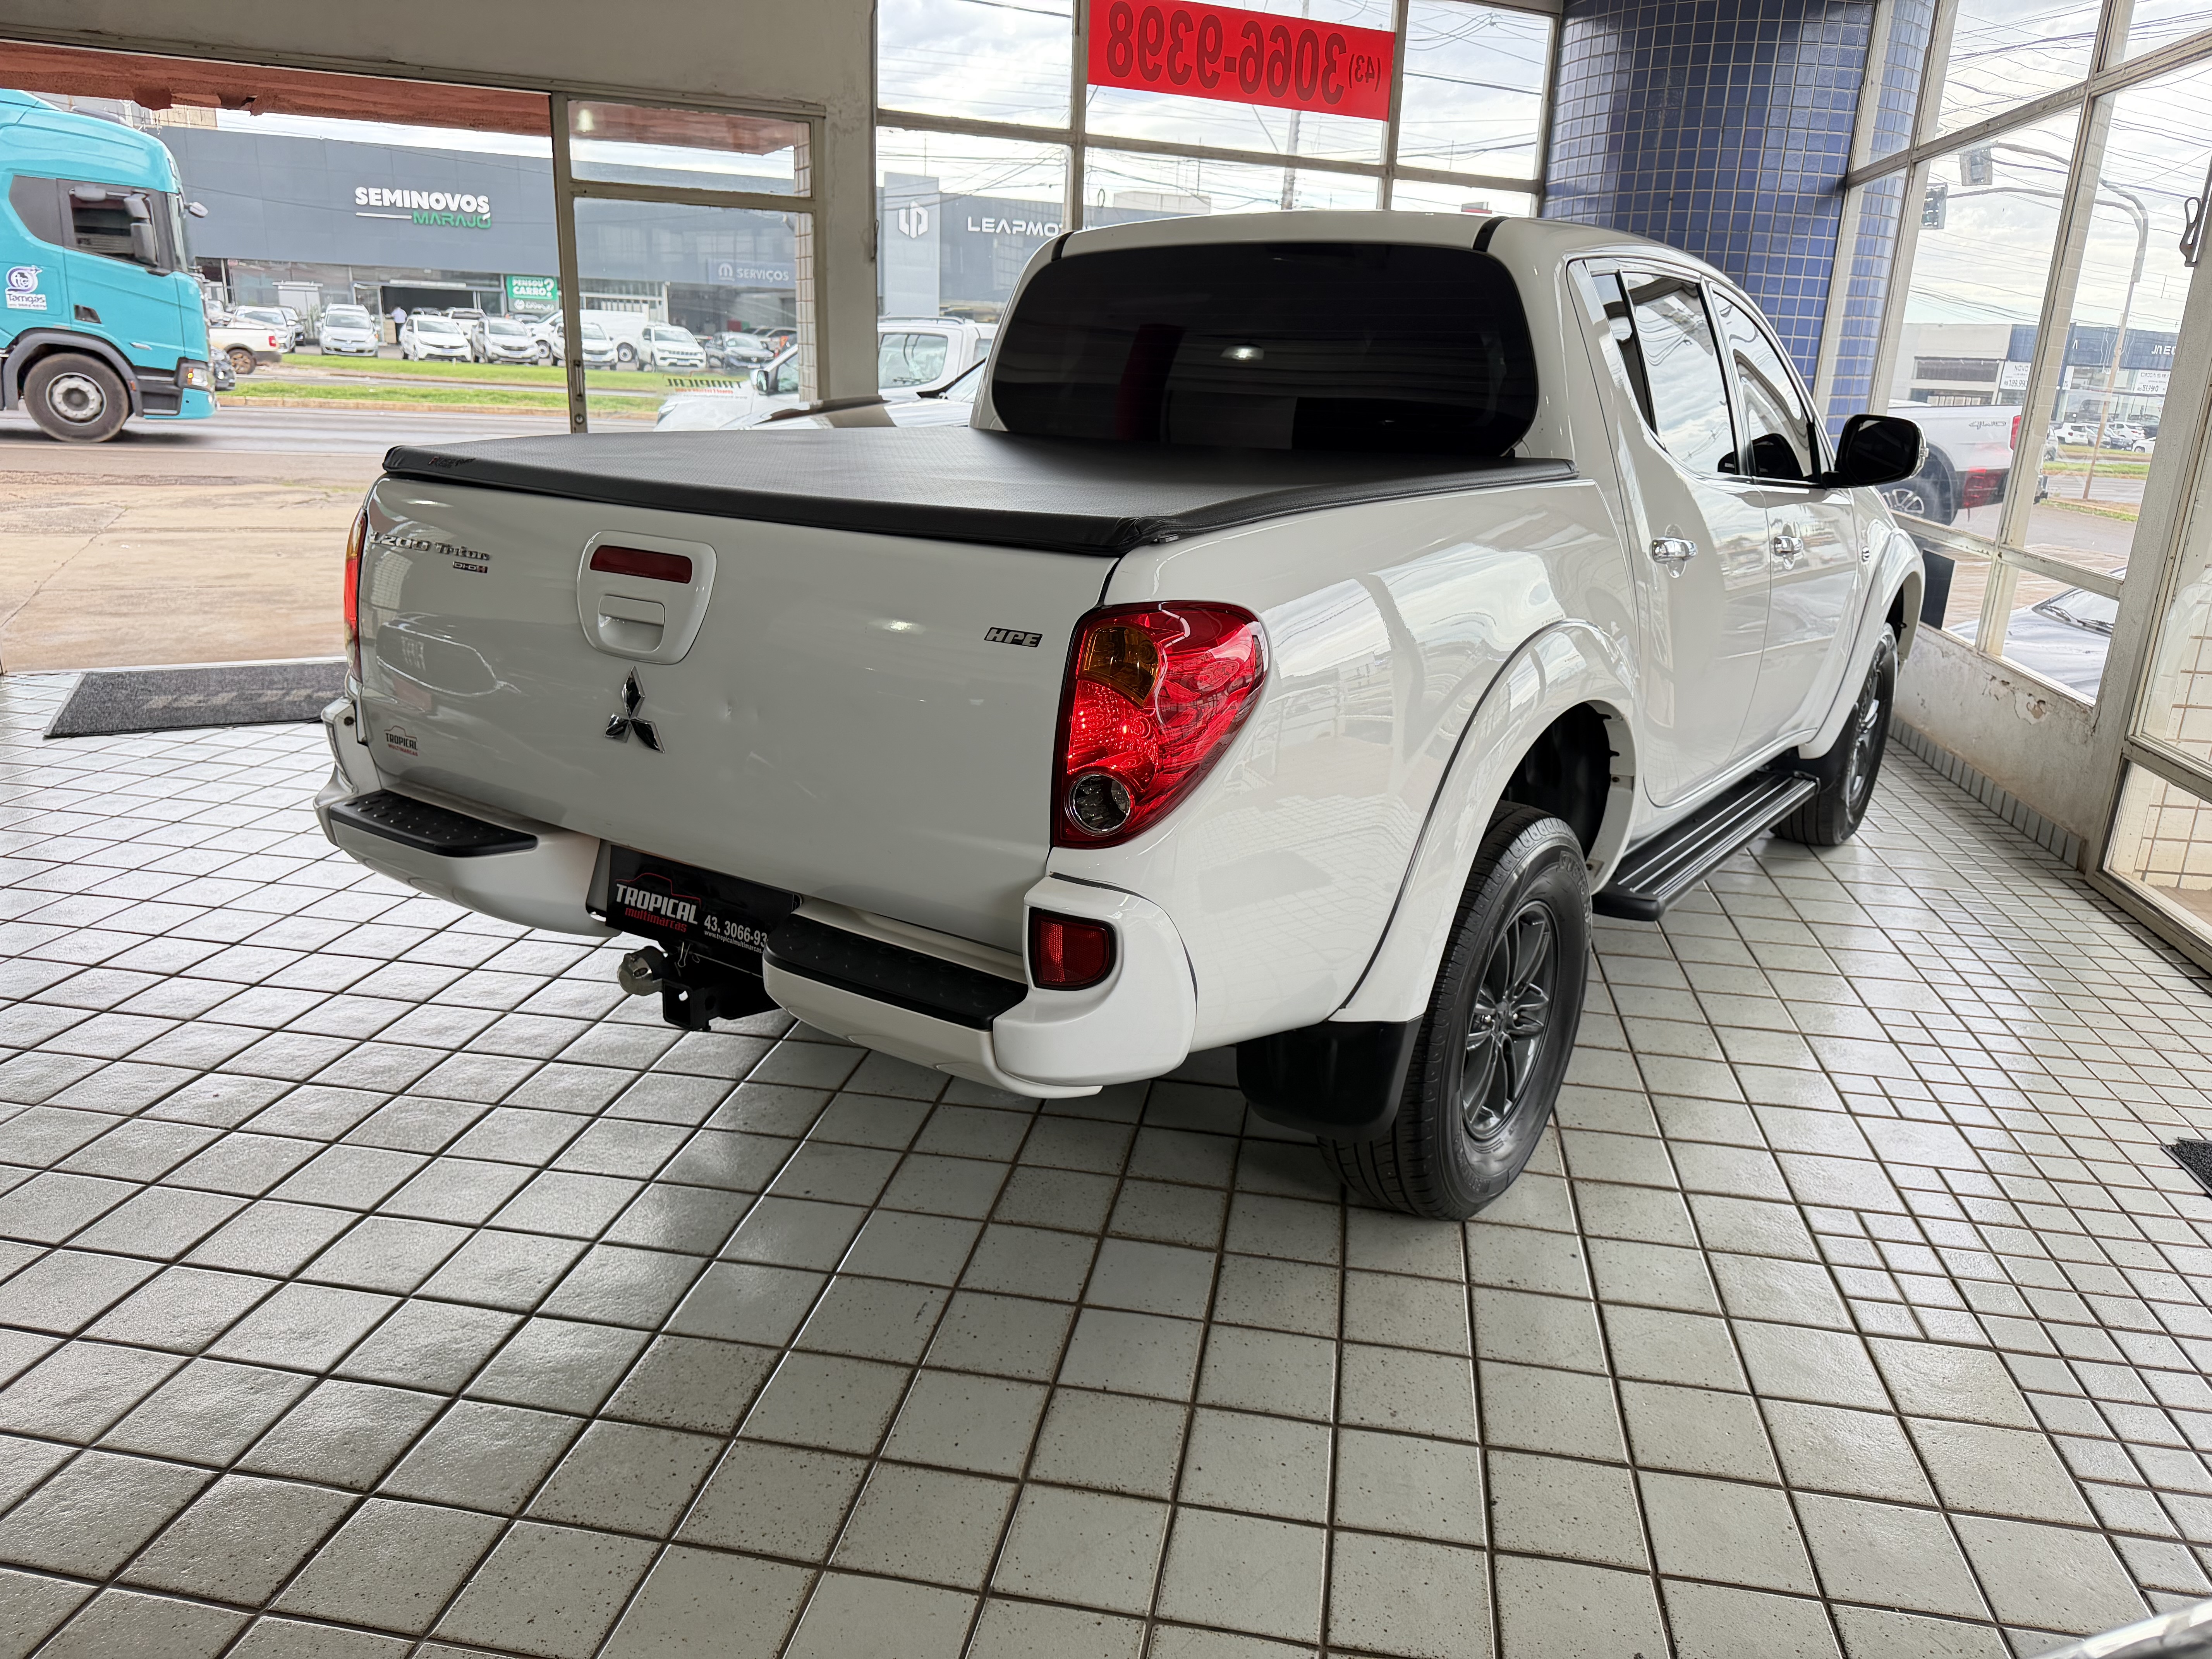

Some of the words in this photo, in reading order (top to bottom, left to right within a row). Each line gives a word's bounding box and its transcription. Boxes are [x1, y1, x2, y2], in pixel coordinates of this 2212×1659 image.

[355, 187, 490, 213] SEMINOVOS
[412, 211, 492, 229] MARAJÓ
[967, 215, 1063, 237] LEAPMO
[736, 268, 789, 283] SERVIÇOS
[433, 541, 490, 561] Triton
[986, 629, 1041, 647] HPE
[385, 732, 418, 751] TROPICAL
[616, 883, 698, 925] TROPICAL
[625, 907, 687, 933] multimarcas
[704, 915, 721, 933] 43.
[724, 921, 769, 948] 3066-93
